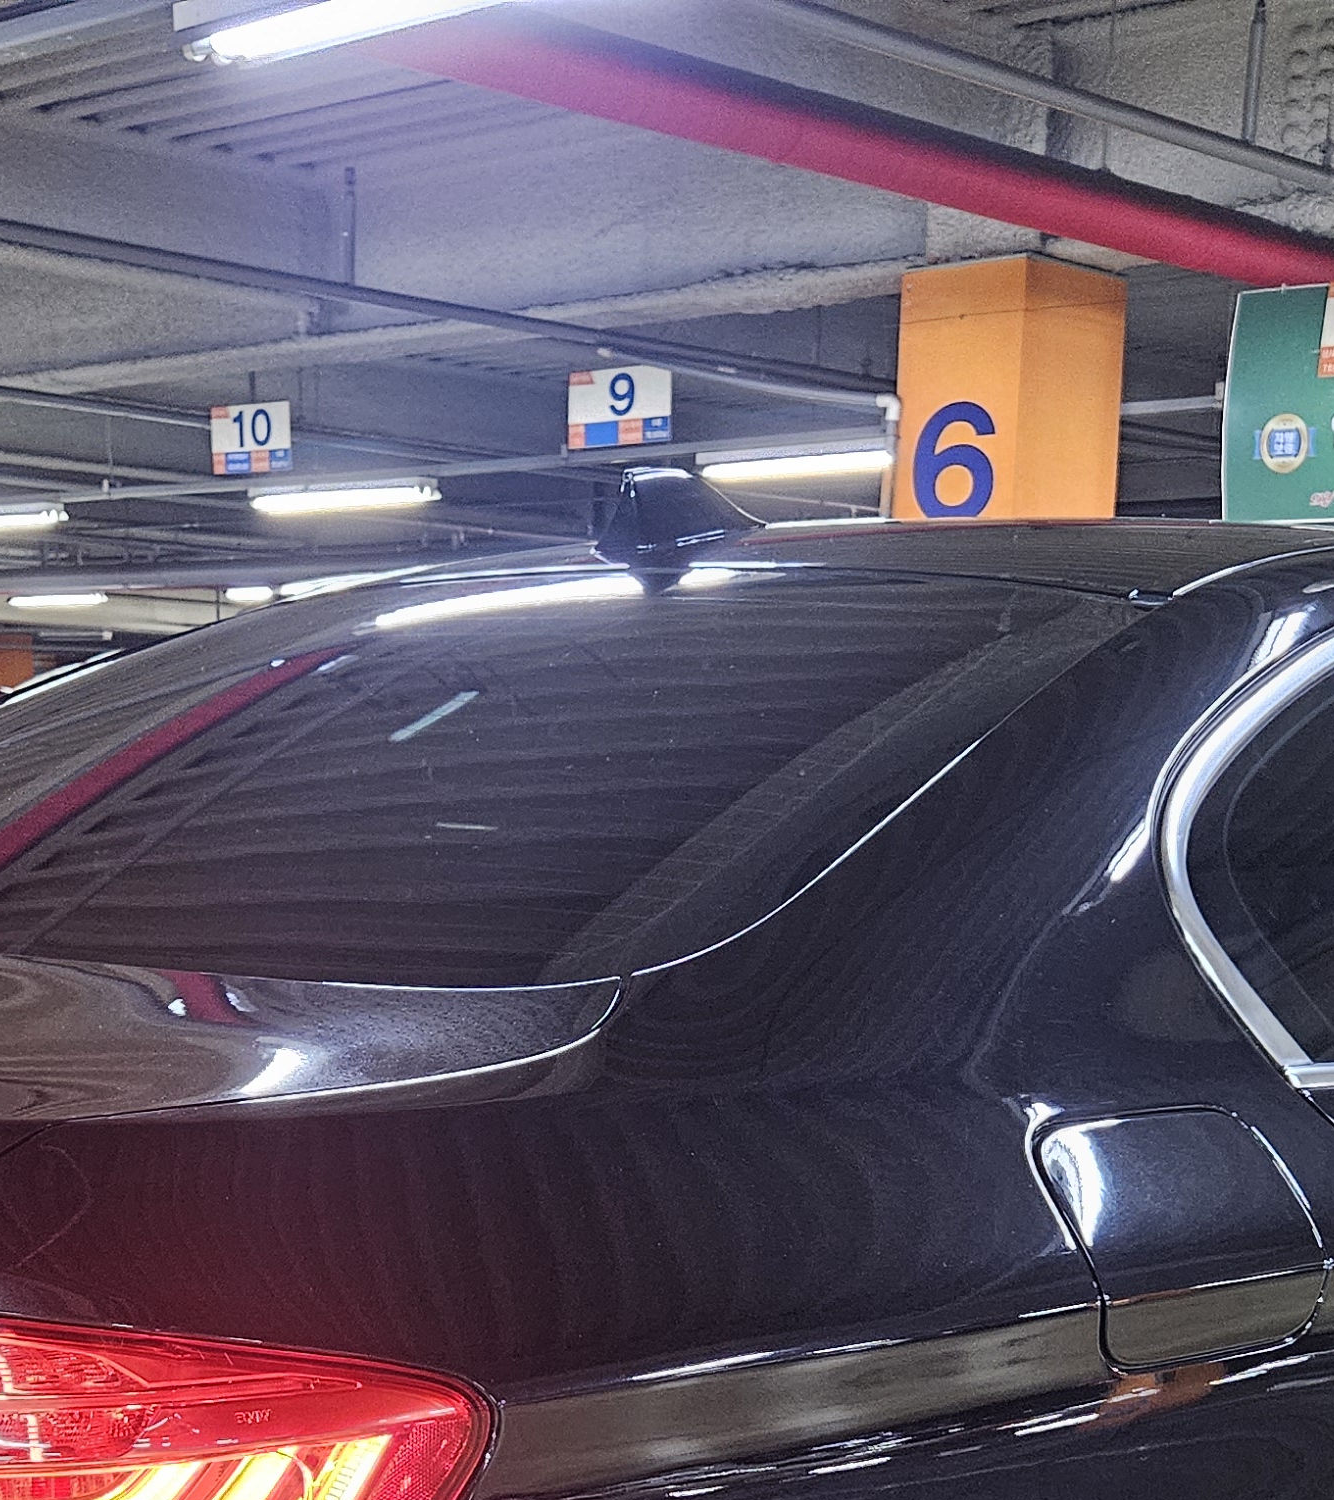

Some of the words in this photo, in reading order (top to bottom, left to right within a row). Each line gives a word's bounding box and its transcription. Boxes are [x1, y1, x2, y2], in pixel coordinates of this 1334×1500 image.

[609, 372, 635, 416] 9
[232, 408, 272, 448] 10
[913, 400, 996, 518] 6
[234, 1408, 272, 1425] BMW
